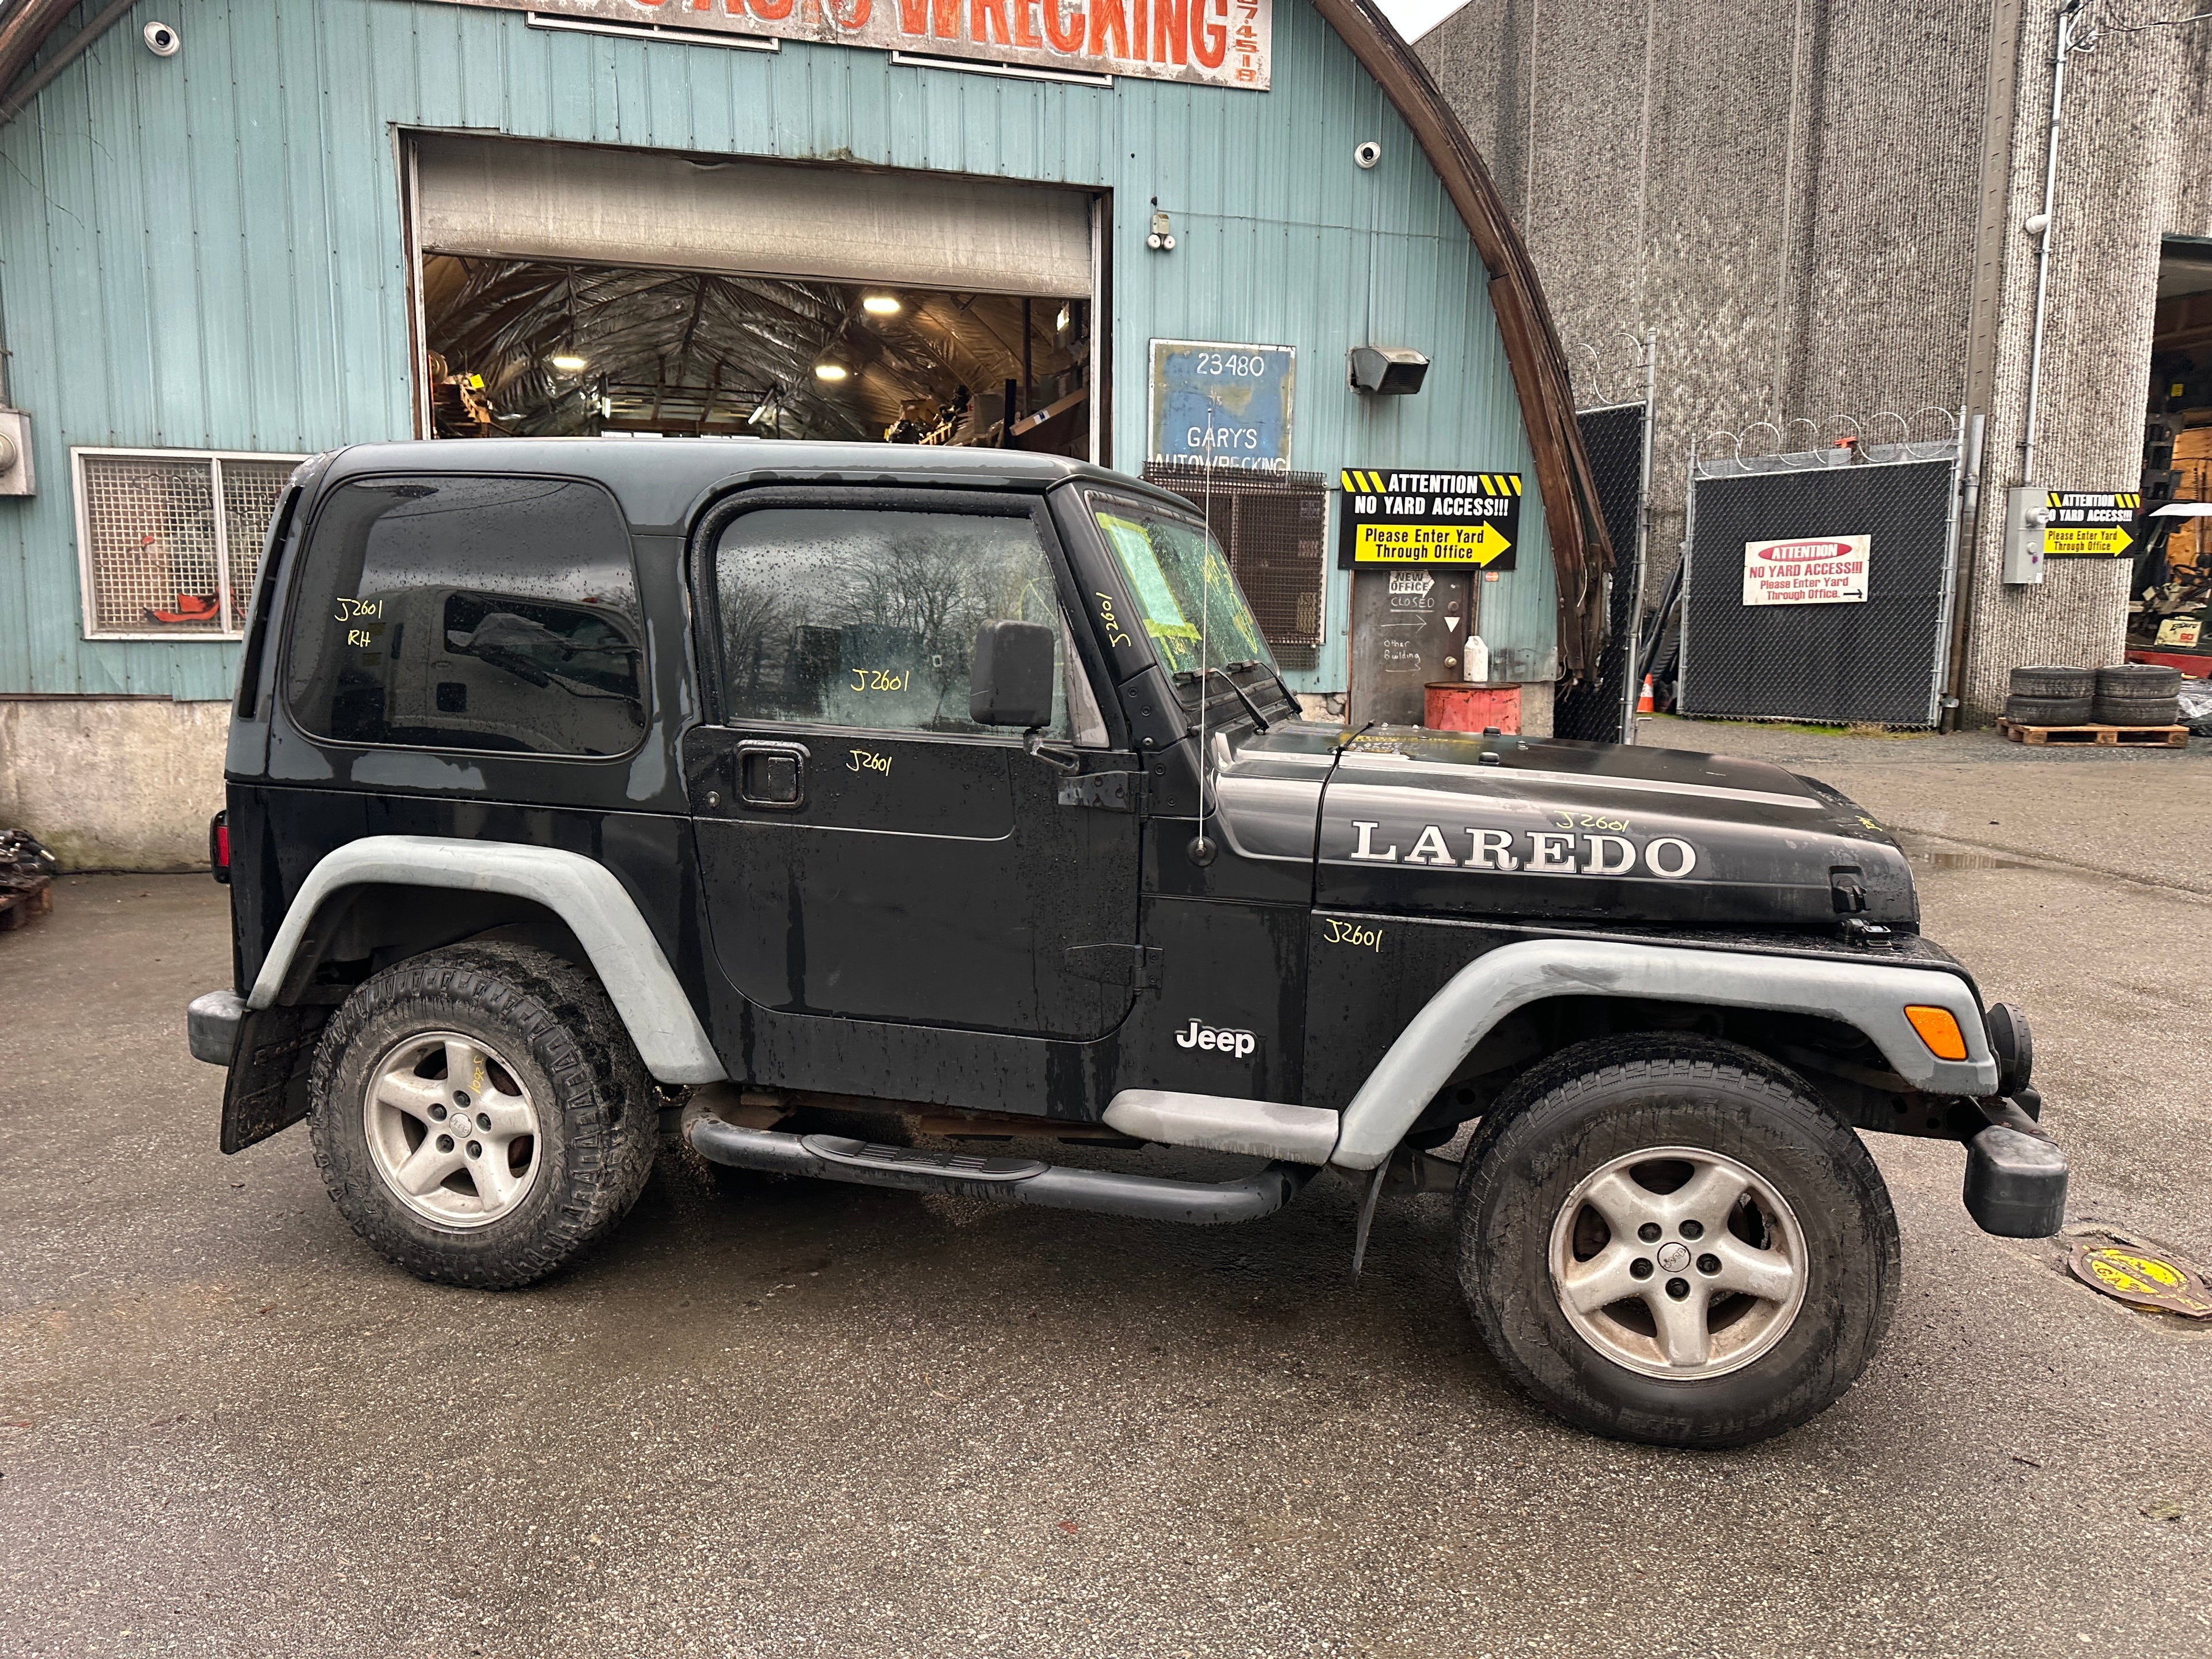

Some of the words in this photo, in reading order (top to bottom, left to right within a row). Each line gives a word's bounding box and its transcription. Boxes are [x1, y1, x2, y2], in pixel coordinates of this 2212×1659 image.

[1196, 353, 1264, 377] 23480
[1187, 426, 1257, 449] GARY'S
[1388, 474, 1478, 494] ATTENTION
[1354, 495, 1377, 514] NO
[1384, 496, 1426, 515] YARD
[1431, 497, 1509, 516] ACCESS!!!
[2062, 494, 2115, 507] ATTENTION
[2048, 509, 2056, 522] O
[2059, 509, 2084, 522] YARD
[2086, 509, 2133, 522] ACCESS!!!
[1365, 528, 1408, 543] Please
[1415, 528, 1450, 543] Enter
[1456, 529, 1484, 543] Yard
[2048, 531, 2074, 540] Please
[2077, 531, 2097, 540] Enter
[2101, 531, 2118, 540] Yard
[1376, 544, 1428, 560] Through
[1434, 544, 1473, 559] Office
[1771, 544, 1838, 560] ATTENTION
[2054, 541, 2084, 552] Through
[2088, 541, 2111, 551] Office
[1396, 572, 1424, 581] NEW
[1749, 566, 1765, 578] NO
[1769, 565, 1801, 578] YARD
[1804, 562, 1863, 576] ACCESS!!!
[1391, 581, 1429, 592] OFFICE
[1760, 579, 1791, 590] Please
[1793, 578, 1821, 588] Enter
[1824, 577, 1849, 587] Yard
[1391, 596, 1435, 608] CLOSED
[1767, 590, 1805, 601] Through
[334, 597, 382, 622] J2601
[1096, 592, 1131, 647] J2601
[347, 629, 372, 647] RH
[1384, 649, 1421, 664] Building
[850, 668, 910, 692] J2601
[846, 750, 892, 777] J2601
[1554, 810, 1630, 832] J2601
[1350, 820, 1696, 877] LAREDO
[1323, 918, 1382, 953] J2601
[1176, 1020, 1255, 1058] Jeep
